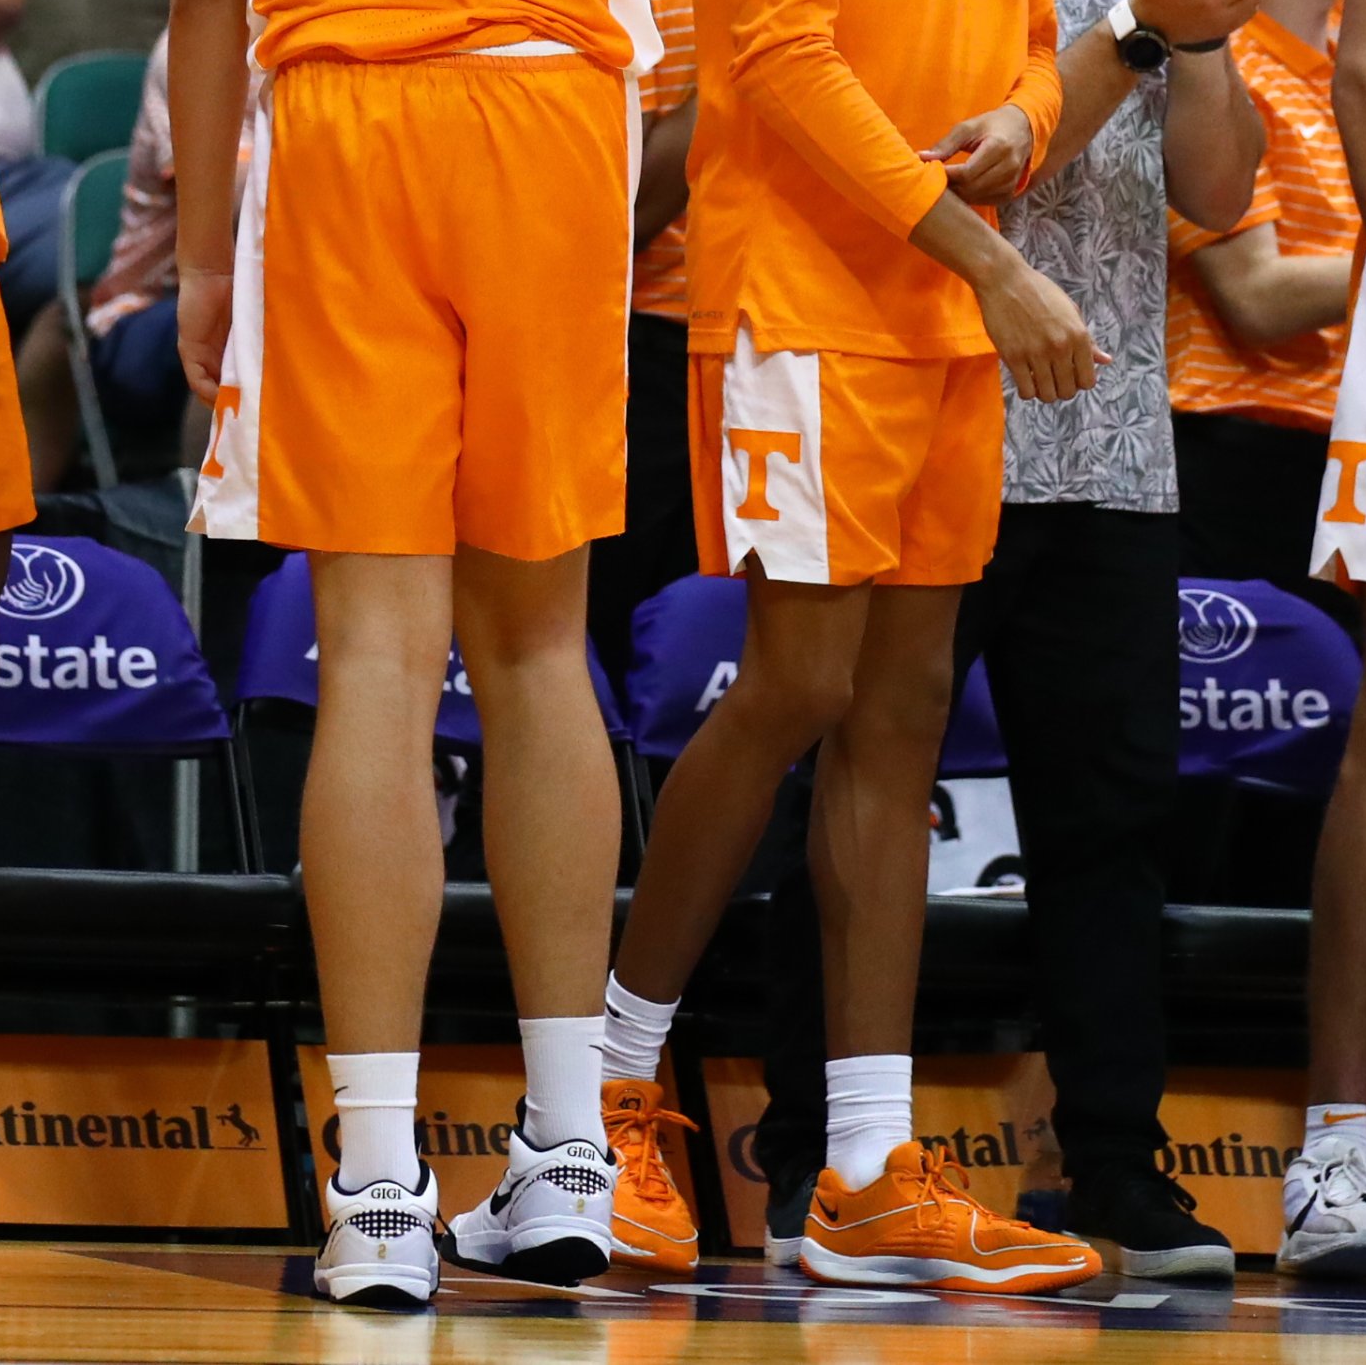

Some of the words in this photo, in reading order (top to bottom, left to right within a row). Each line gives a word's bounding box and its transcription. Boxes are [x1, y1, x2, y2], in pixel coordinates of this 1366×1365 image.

[729, 430, 801, 521] T
[1179, 677, 1330, 730] state
[567, 1145, 596, 1161] GIGI
[370, 1187, 402, 1200] GIGI
